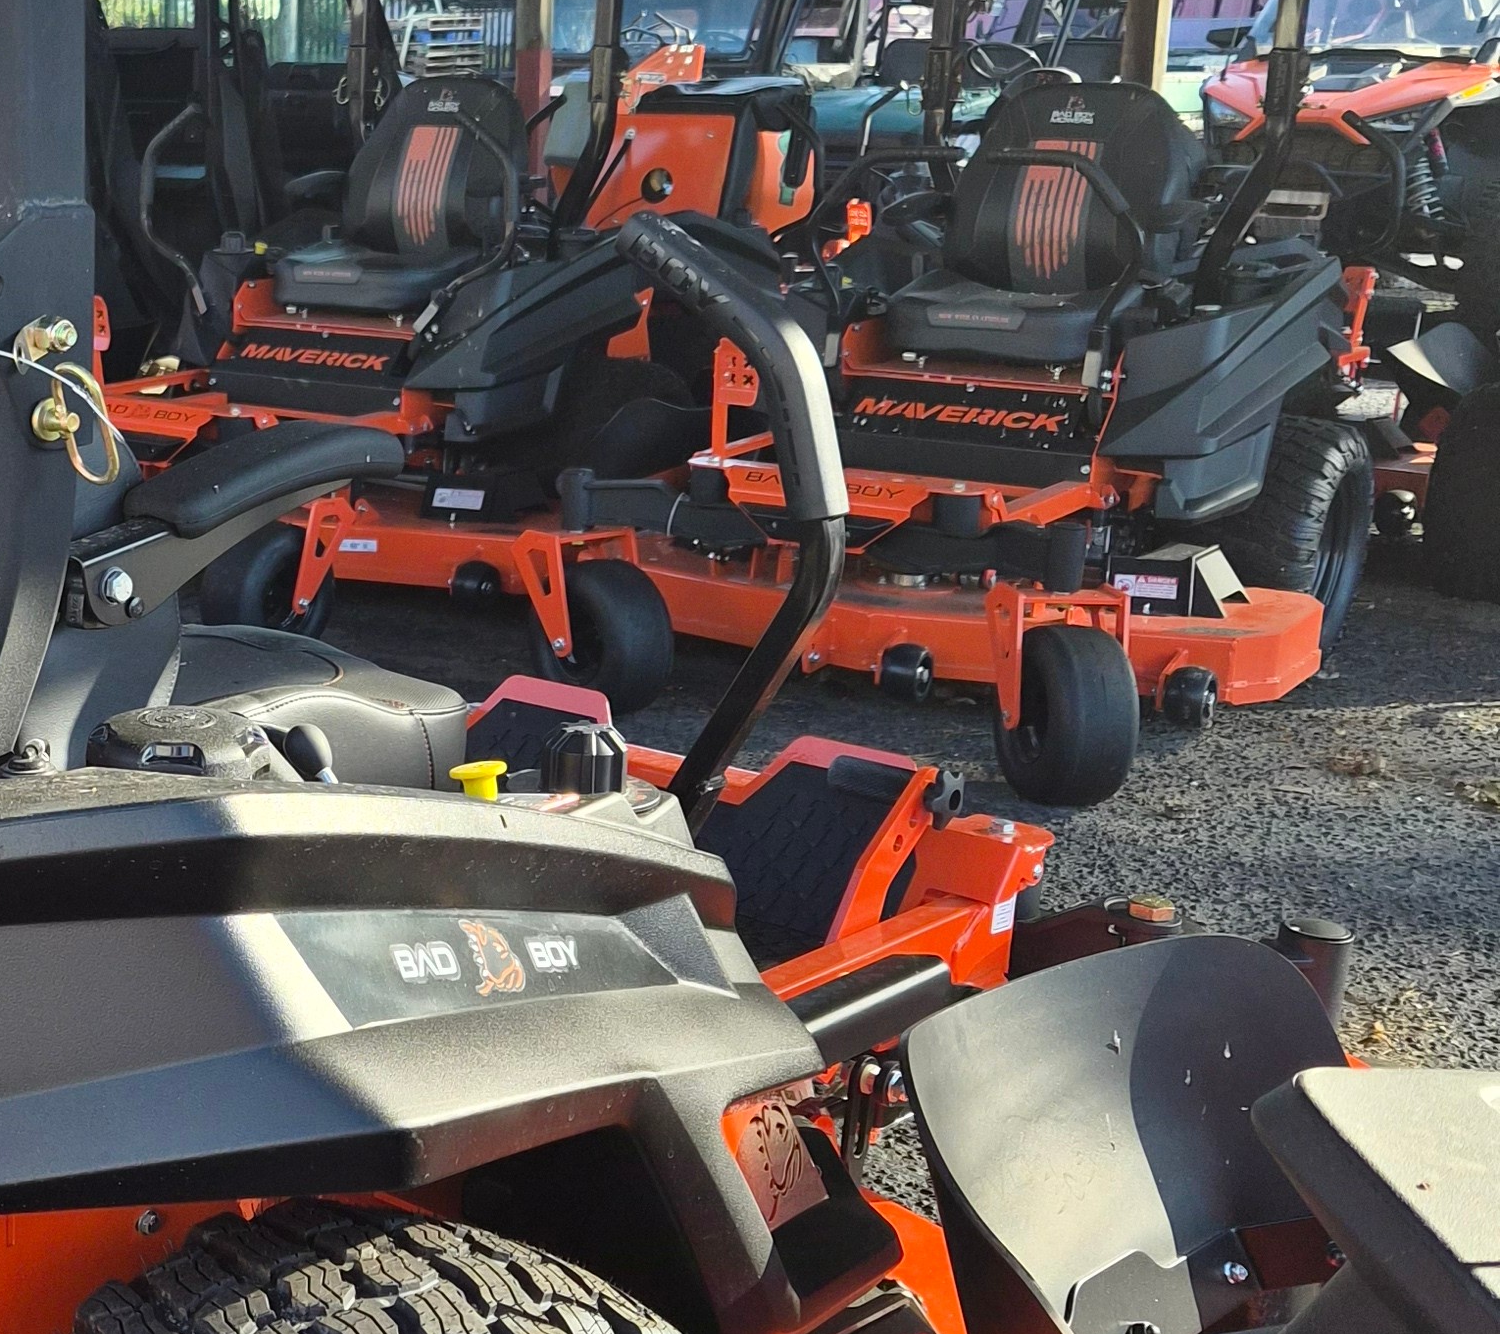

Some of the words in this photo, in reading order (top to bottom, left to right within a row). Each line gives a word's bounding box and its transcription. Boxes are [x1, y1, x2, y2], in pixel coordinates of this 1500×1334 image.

[240, 344, 390, 371] MAVERICK
[153, 409, 198, 423] BOY
[853, 397, 1068, 432] MAVERICK
[392, 946, 458, 980] BAD
[527, 940, 579, 969] BOY
